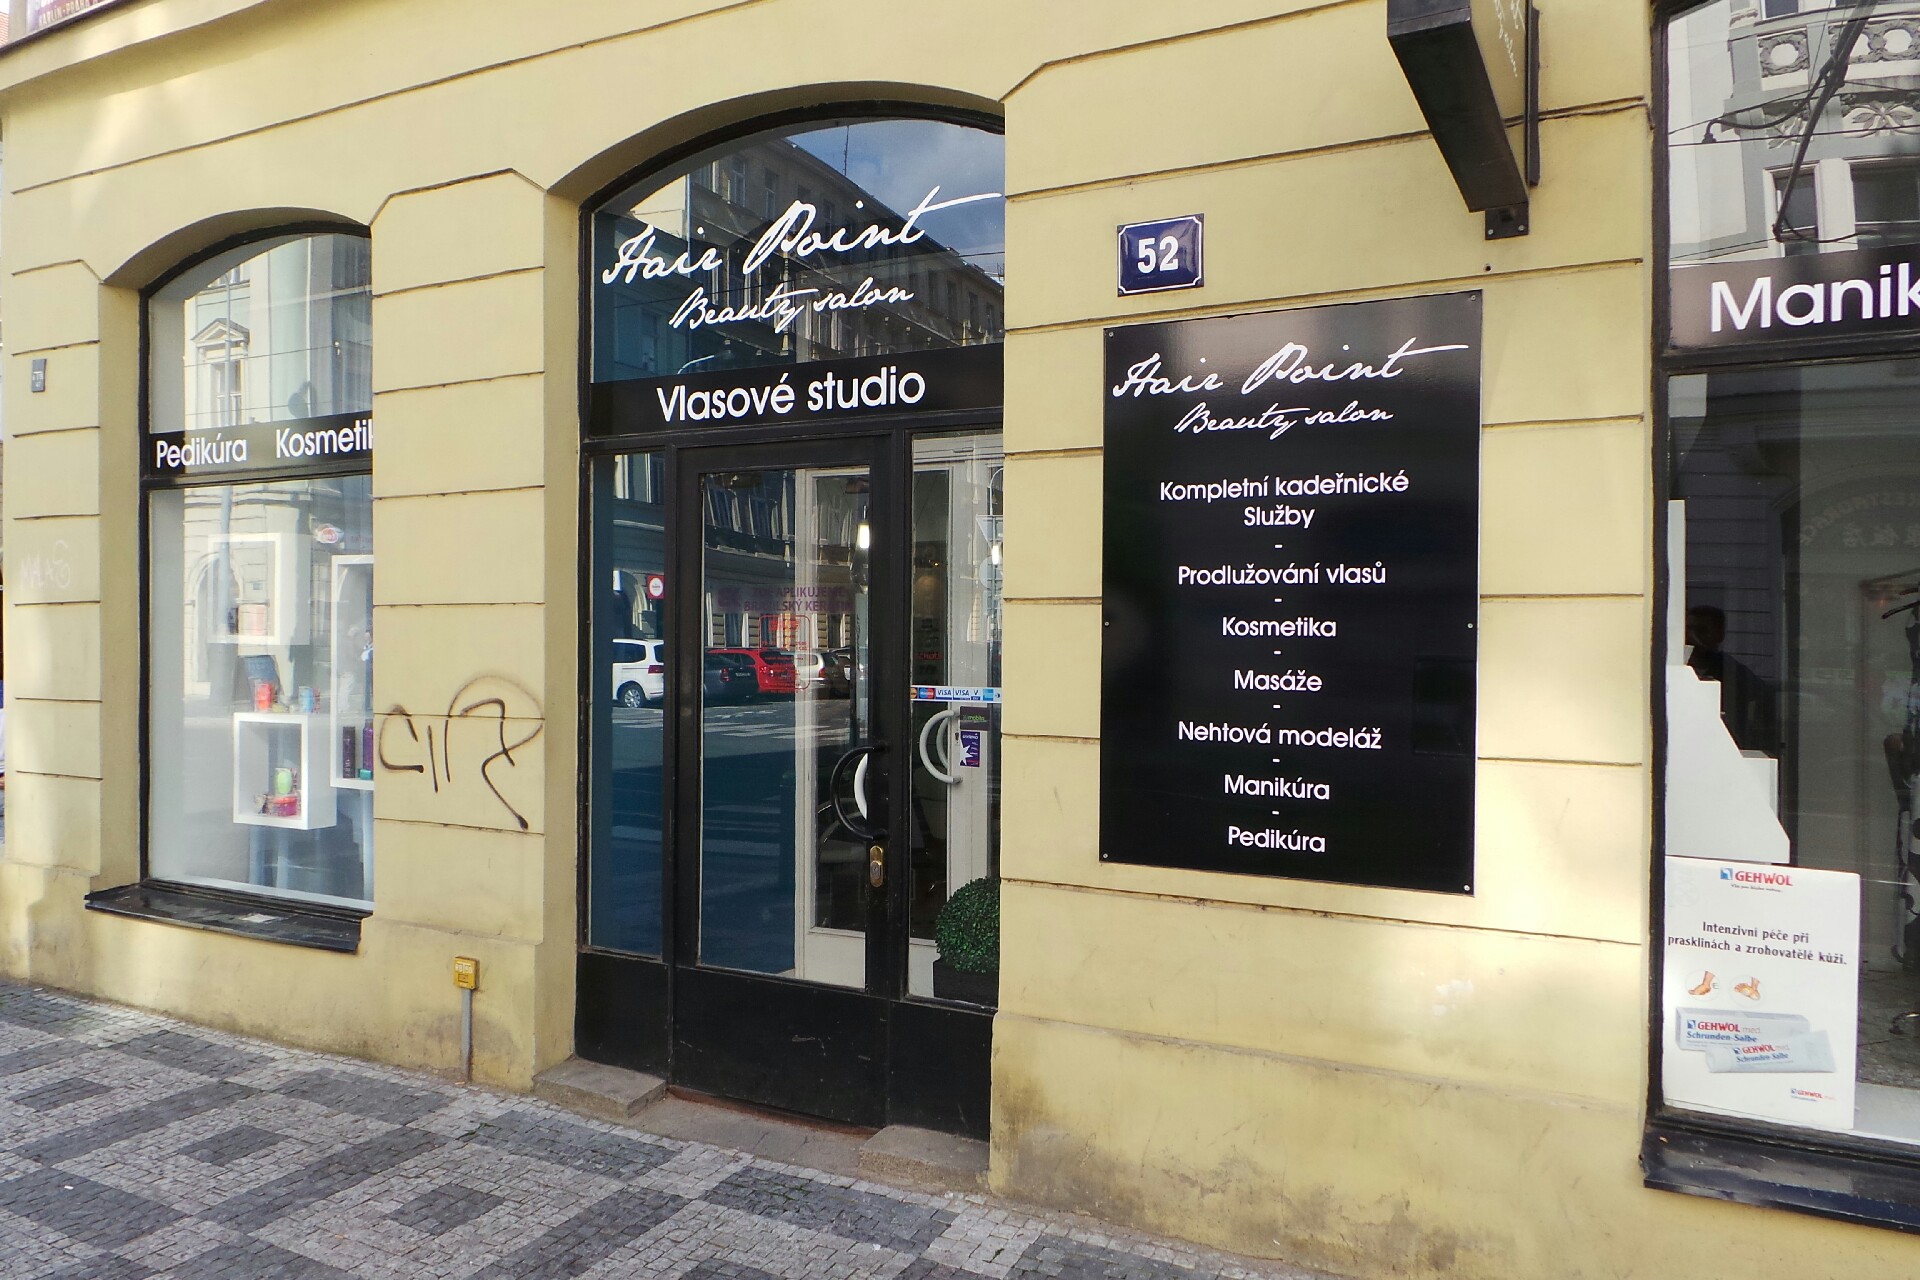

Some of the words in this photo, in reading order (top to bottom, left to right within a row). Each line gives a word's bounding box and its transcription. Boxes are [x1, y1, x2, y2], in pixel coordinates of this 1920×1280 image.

[602, 224, 722, 284] Hair
[742, 186, 1003, 274] Point
[1137, 235, 1179, 274] 52
[668, 286, 819, 333] Beauty
[812, 276, 915, 312] salon
[1112, 352, 1224, 398] Hair
[1241, 337, 1470, 396] Point
[656, 373, 795, 422] Vlasové
[807, 366, 926, 411] studio
[1173, 402, 1312, 440] Beauty
[1304, 400, 1394, 426] salon
[155, 432, 248, 469] Pedikúra
[1160, 475, 1269, 504] Kompletní
[1275, 469, 1410, 496] kadeřnické
[1243, 504, 1316, 529] Služby
[1178, 564, 1320, 585] Prodlužování
[1325, 560, 1387, 585] vlasů
[1222, 616, 1337, 638] Kosmetika
[1234, 669, 1323, 692] Masáže
[1178, 720, 1271, 745] Nehtová
[1278, 726, 1382, 750] modeláž
[1224, 774, 1330, 800] Manikúra
[1228, 825, 1326, 853] Pedikúra
[1734, 870, 1793, 887] GEHWOL
[1667, 935, 1731, 951] prasklinách
[1734, 944, 1742, 952] a
[1762, 928, 1789, 941] péče
[1793, 932, 1810, 945] při
[1697, 1021, 1741, 1033] GEHWOL
[1742, 1044, 1776, 1054] GEHWOL
